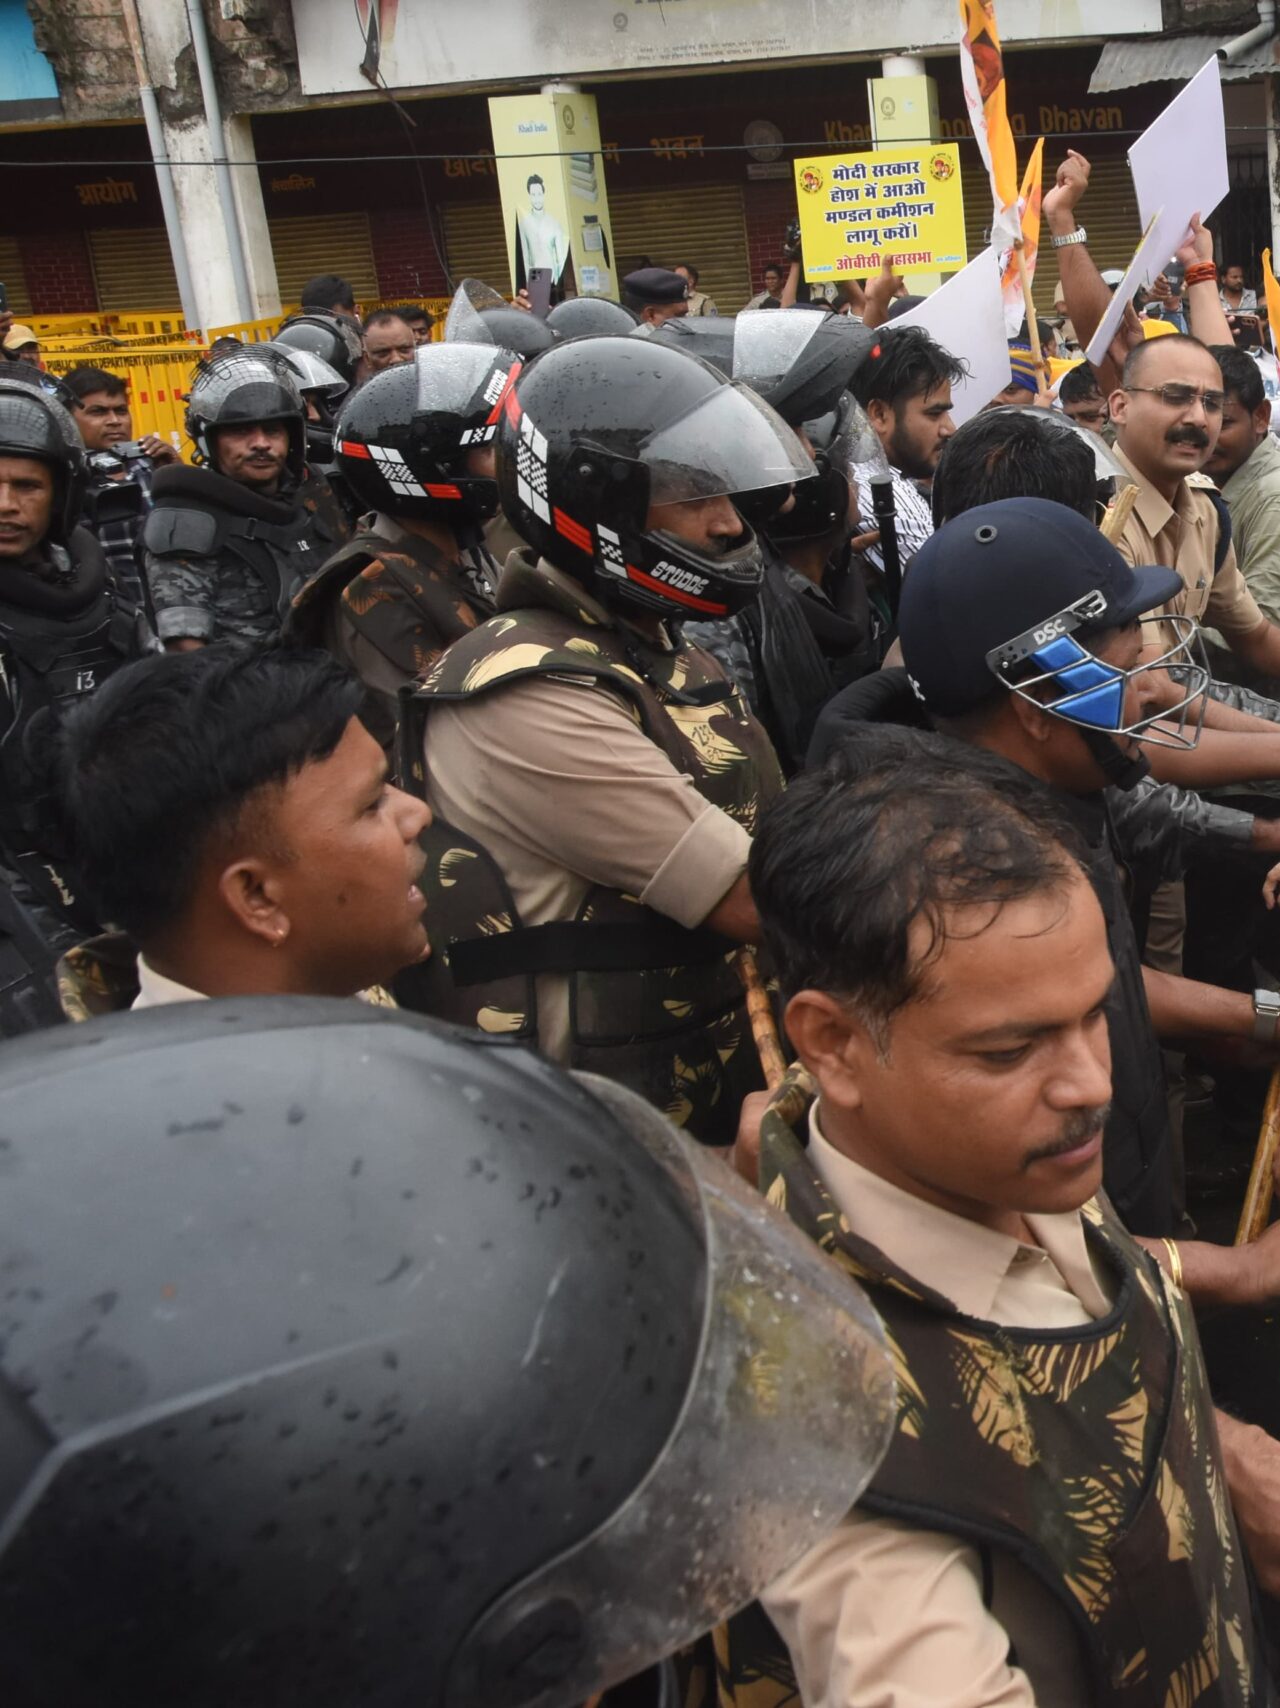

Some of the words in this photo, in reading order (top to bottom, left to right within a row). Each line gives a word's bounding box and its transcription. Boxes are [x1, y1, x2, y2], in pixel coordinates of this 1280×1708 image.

[832, 163, 867, 181] मोदी
[872, 161, 920, 178] सरकार
[830, 186, 859, 203] होश
[865, 182, 878, 200] में
[883, 179, 926, 198] आओ
[825, 209, 872, 224] मण्डल
[876, 201, 934, 219] कमीशन
[846, 229, 882, 246] लागू
[100, 354, 142, 369] DEPARTMENT
[483, 368, 509, 406] STUDDS
[650, 560, 710, 596] STUDDS
[1033, 618, 1066, 646] DSC
